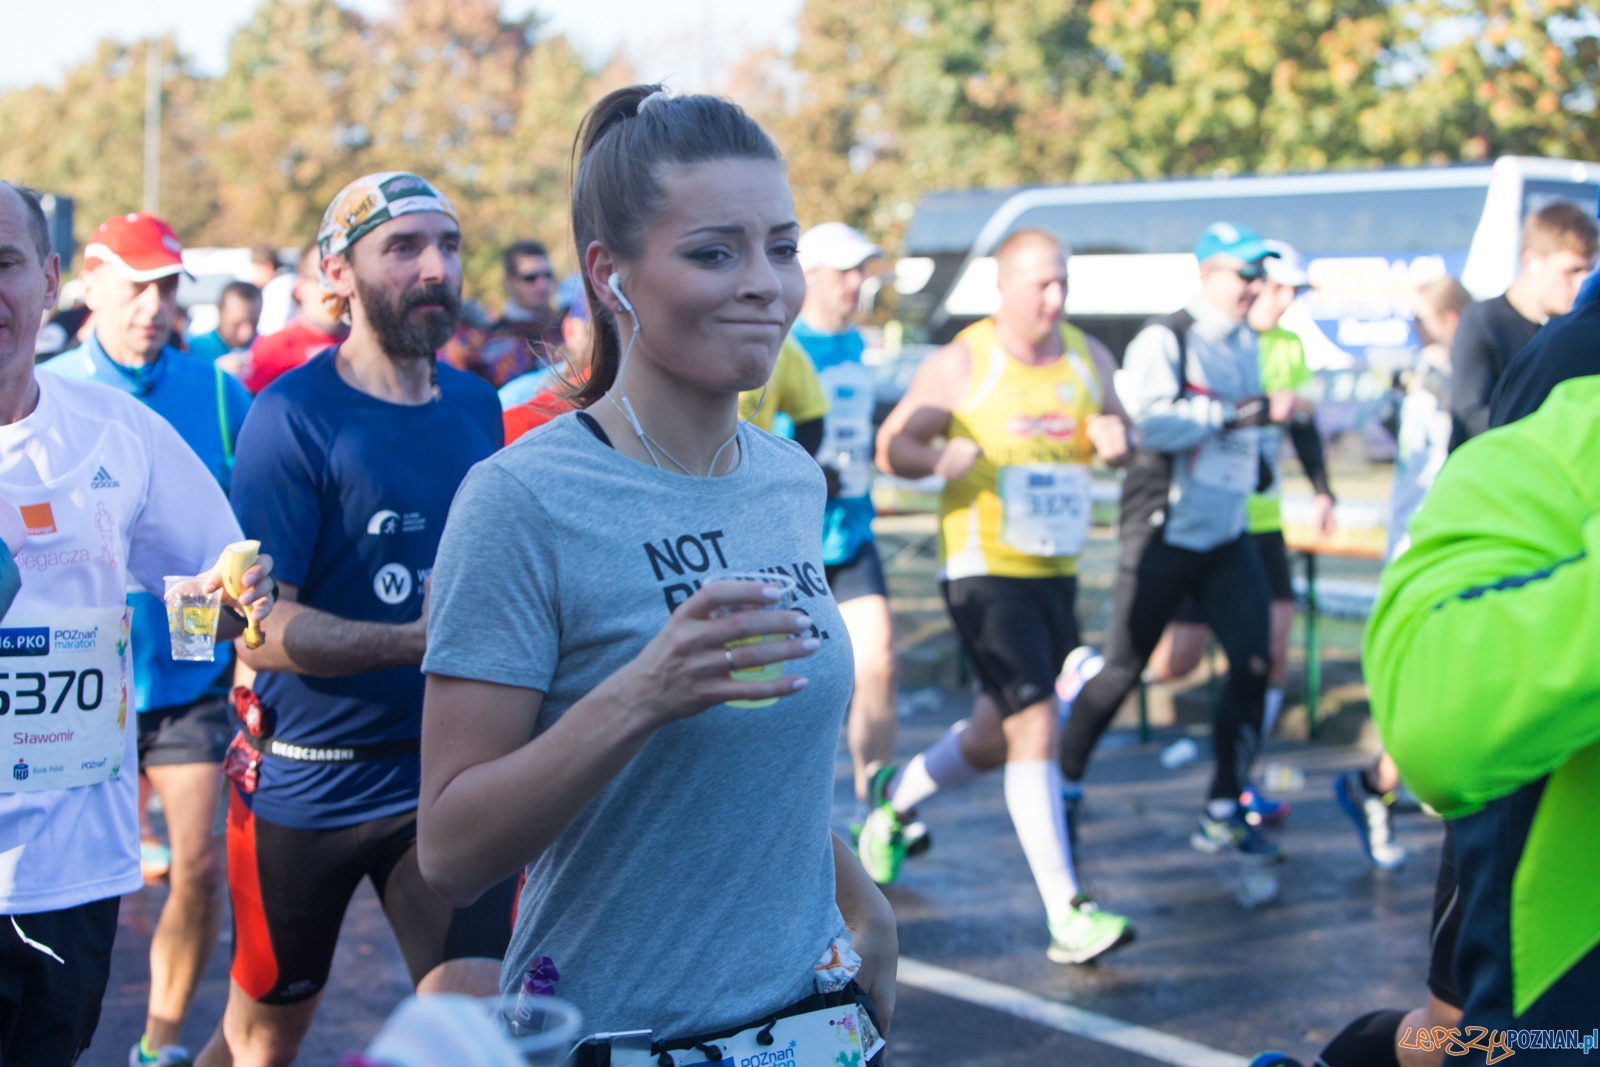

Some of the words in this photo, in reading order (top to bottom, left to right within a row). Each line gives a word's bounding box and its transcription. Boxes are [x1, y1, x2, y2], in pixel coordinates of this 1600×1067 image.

[643, 530, 729, 582] NOT
[17, 634, 46, 649] PKO
[55, 639, 97, 650] maraton
[13, 730, 75, 745] Sławomir
